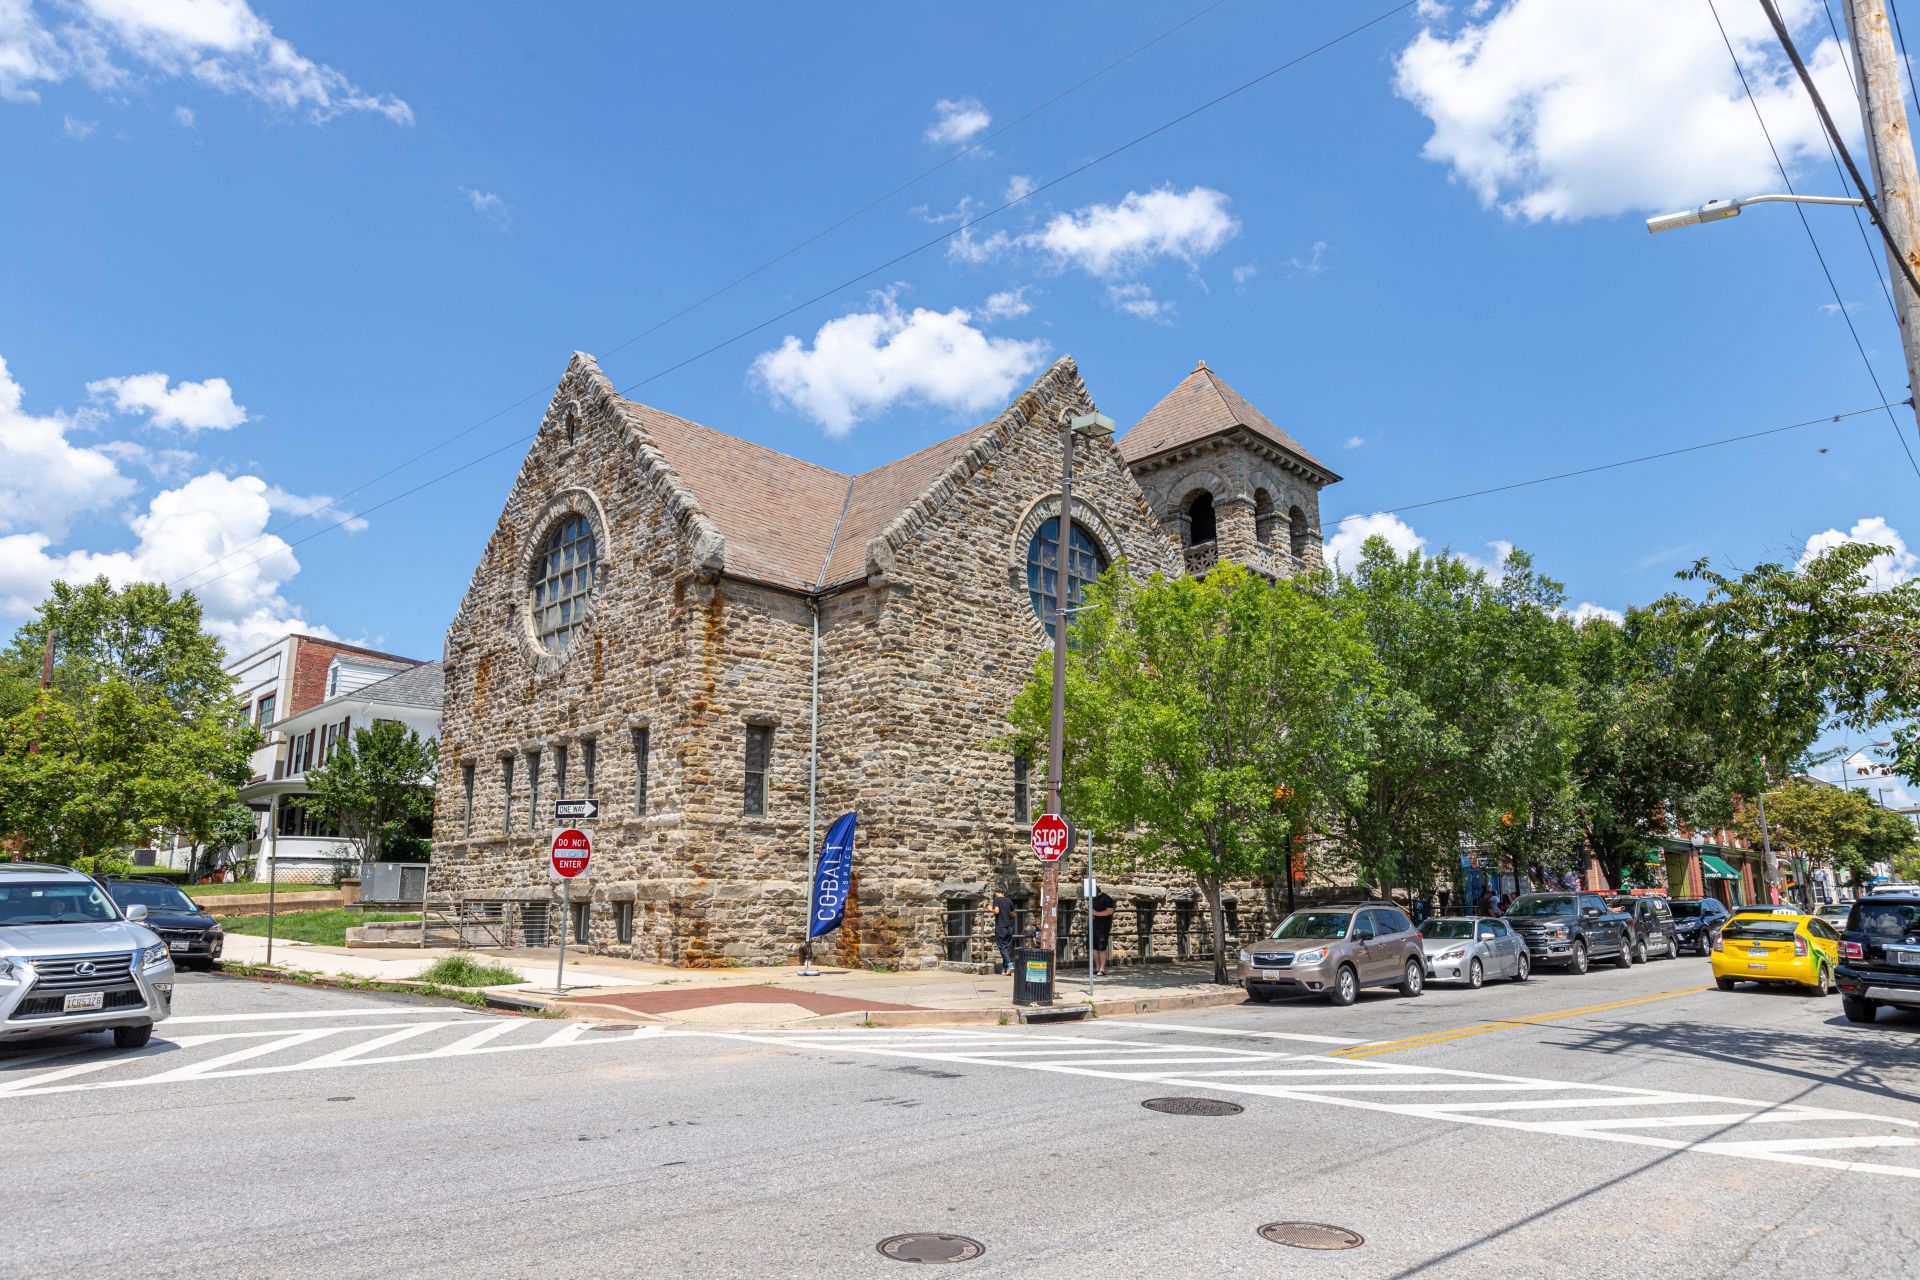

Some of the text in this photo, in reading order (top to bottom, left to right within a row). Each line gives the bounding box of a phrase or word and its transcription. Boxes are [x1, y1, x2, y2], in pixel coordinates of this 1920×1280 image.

[559, 805, 585, 814] ONE WAY
[1034, 829, 1065, 846] STOP
[558, 839, 586, 847] DO NOT
[559, 860, 582, 869] ENTER
[817, 843, 842, 920] COBALT
